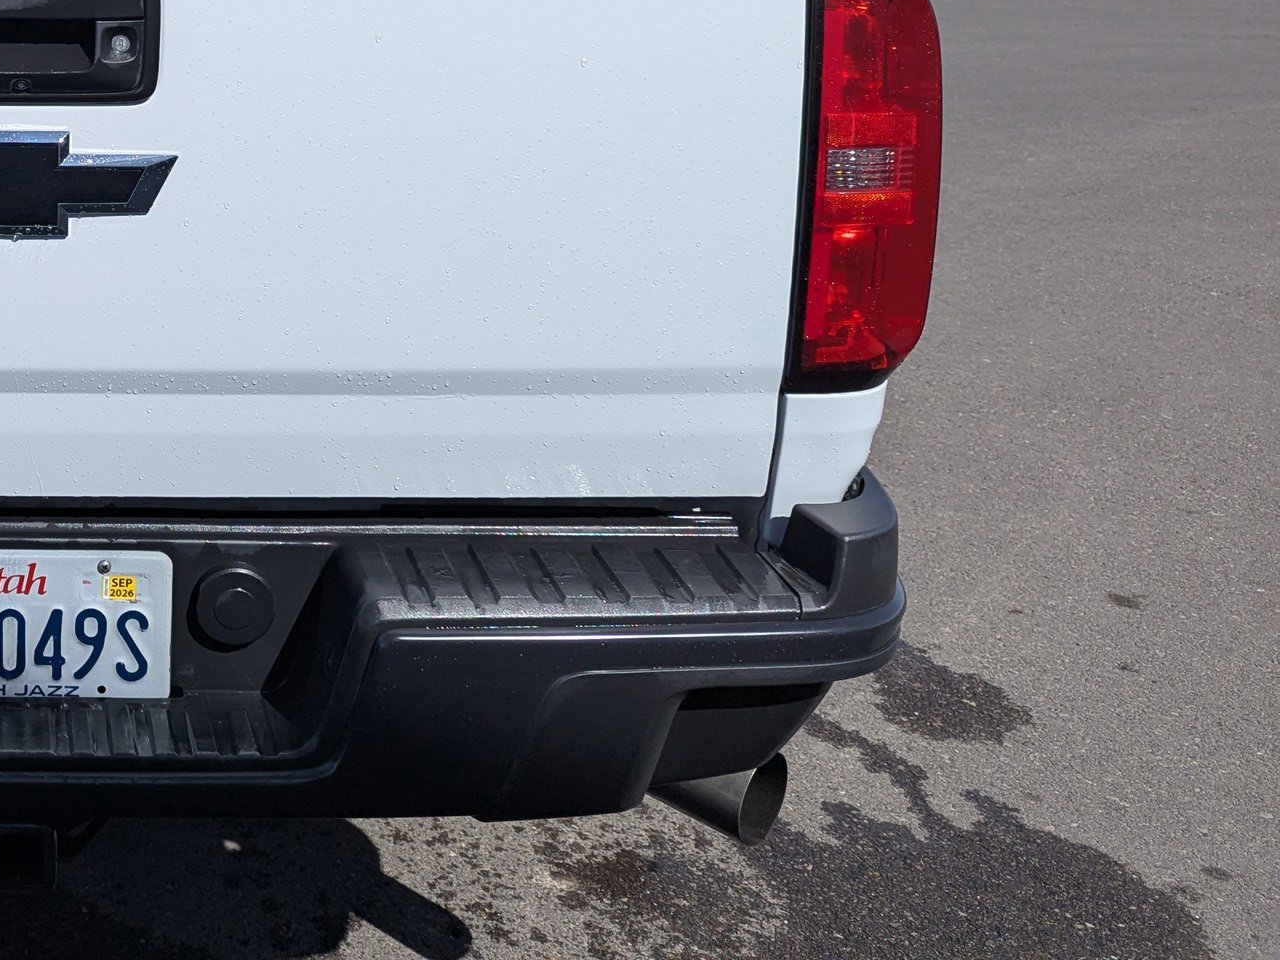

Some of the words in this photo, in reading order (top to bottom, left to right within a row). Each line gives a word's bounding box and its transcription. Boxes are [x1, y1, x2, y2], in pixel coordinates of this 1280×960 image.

[111, 578, 133, 587] SEP
[110, 589, 134, 597] 2026
[14, 684, 80, 698] JAZZ
